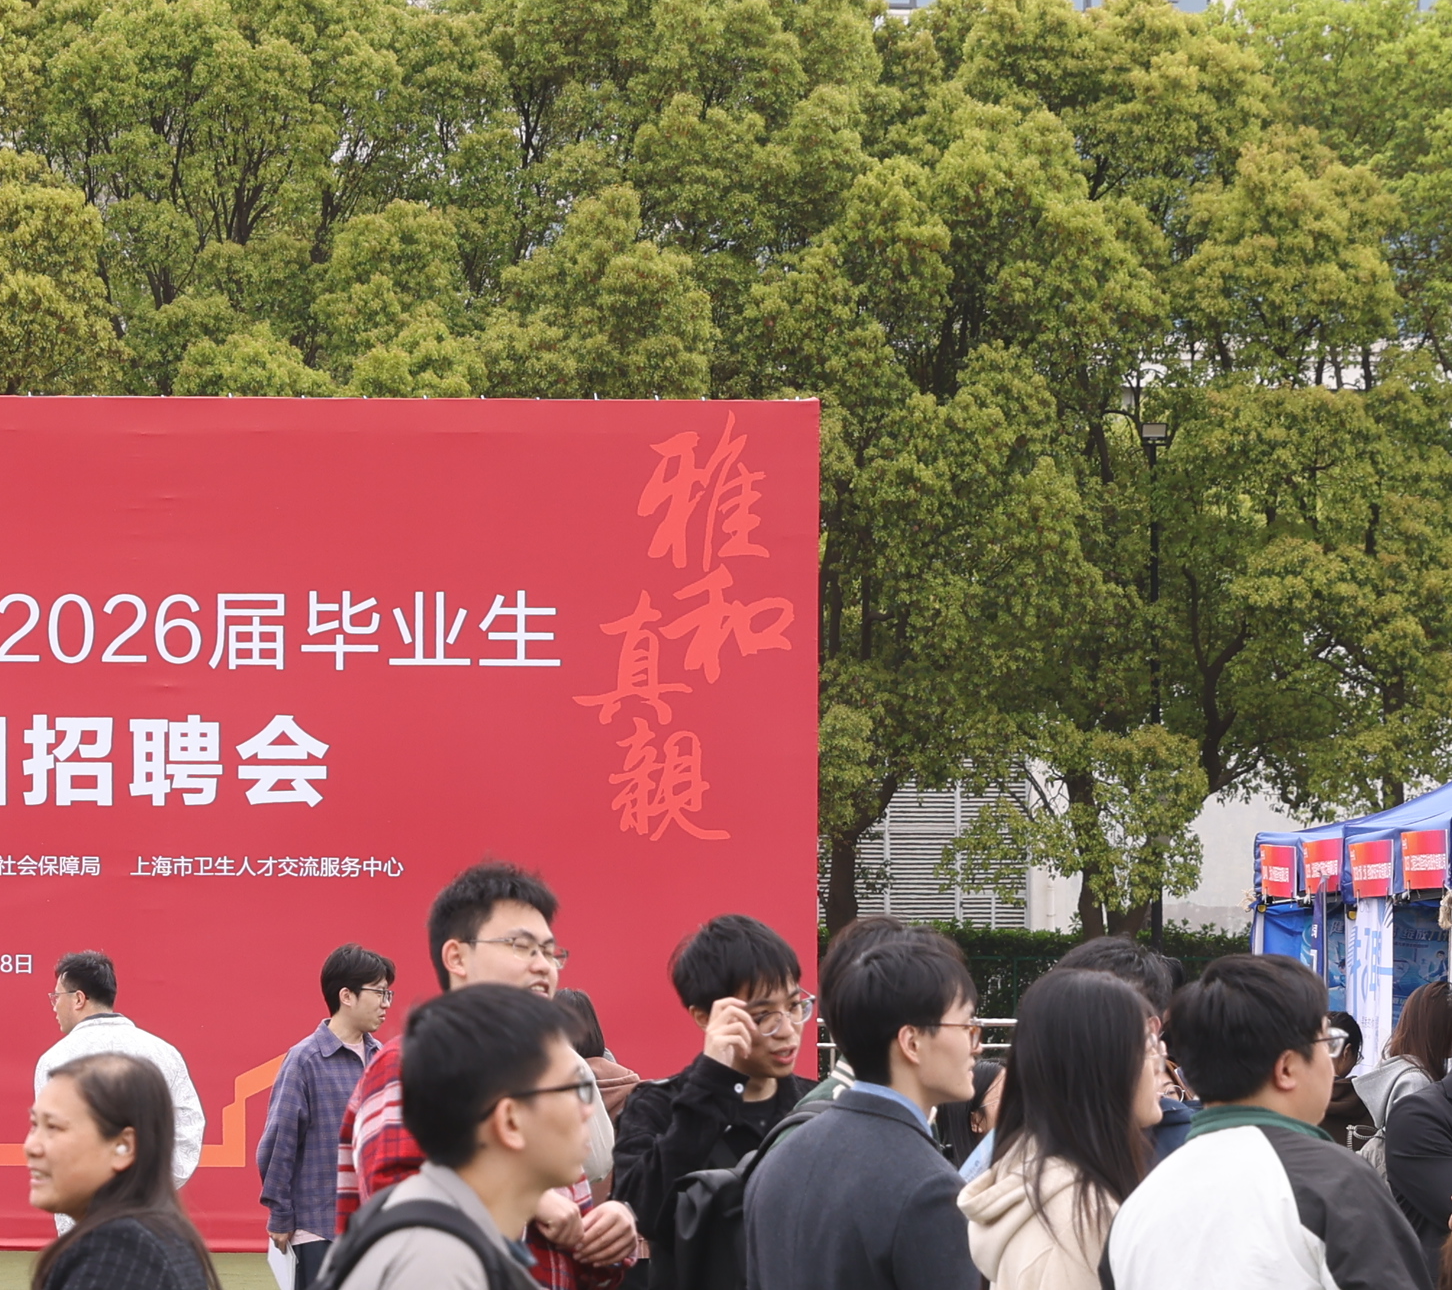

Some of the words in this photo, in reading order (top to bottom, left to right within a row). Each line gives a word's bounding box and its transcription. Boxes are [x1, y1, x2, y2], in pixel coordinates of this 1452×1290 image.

[130, 856, 404, 878] 上海市卫生人才交流服务中心
